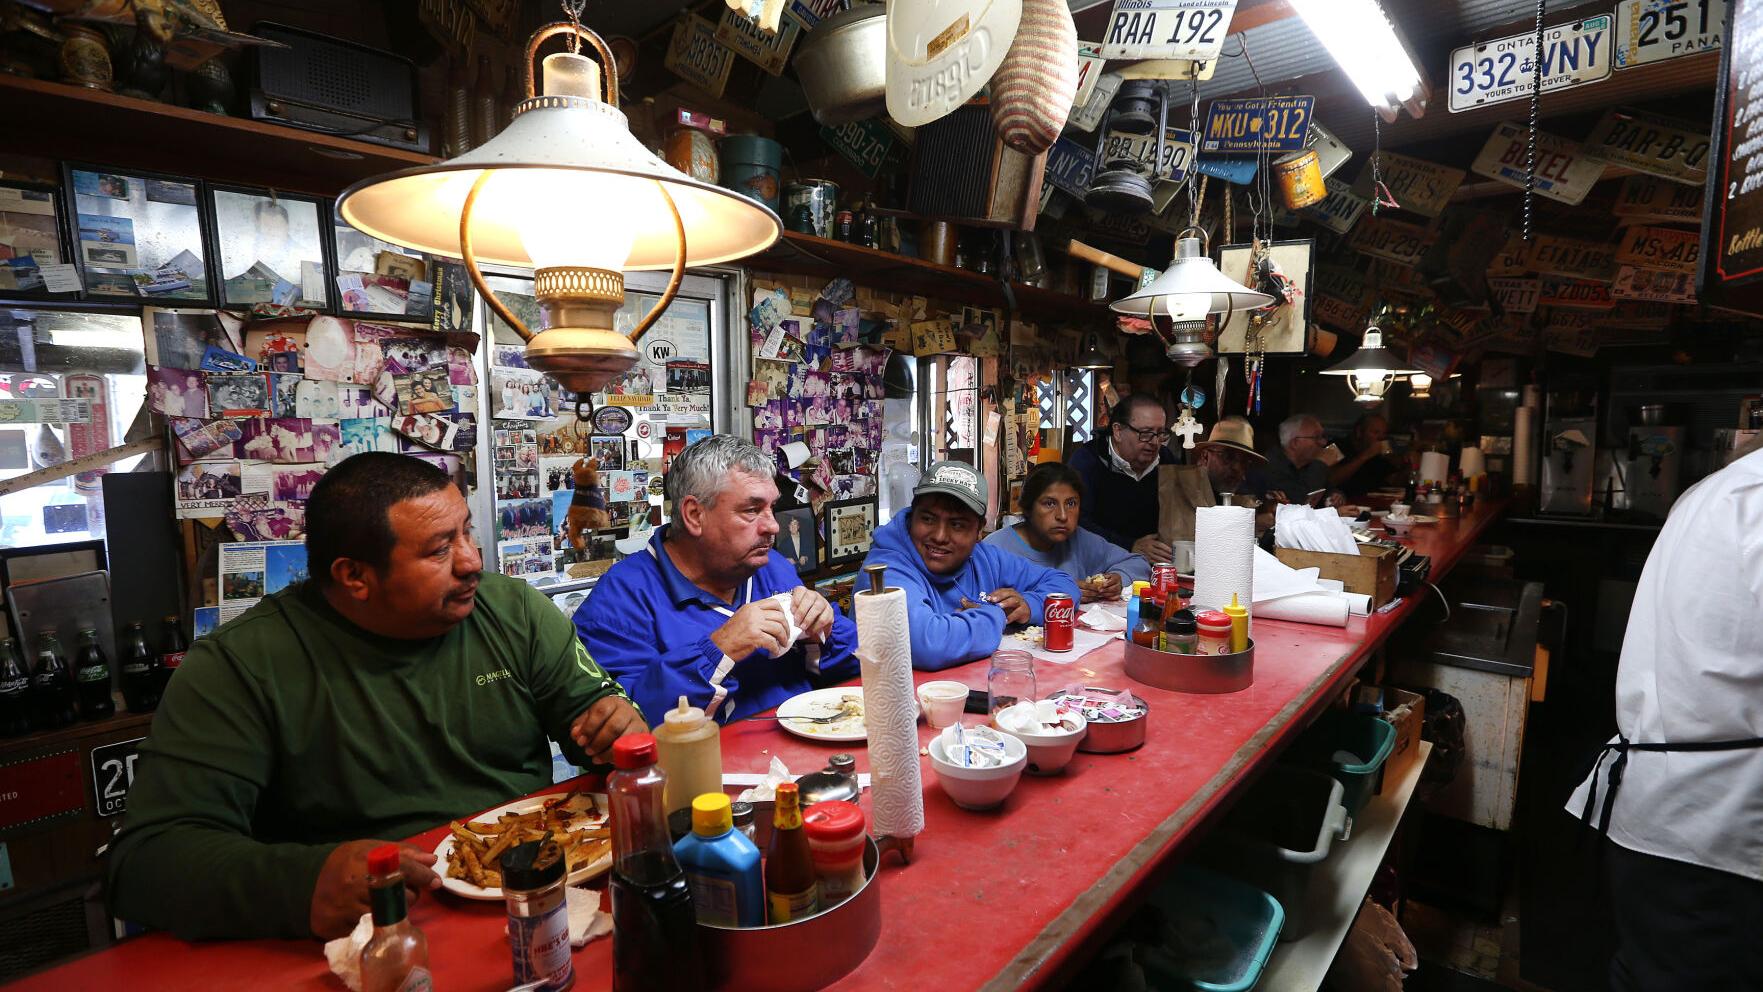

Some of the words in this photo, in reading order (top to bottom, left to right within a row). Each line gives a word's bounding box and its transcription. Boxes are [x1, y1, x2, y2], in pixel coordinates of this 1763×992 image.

[1119, 0, 1152, 9] Illinois
[1109, 12, 1157, 44] RAA
[1167, 9, 1223, 44] 192
[1496, 31, 1562, 52] ONTAIO
[1457, 53, 1517, 95] 332
[1539, 33, 1603, 77] VNY
[1485, 87, 1512, 98] YOURS
[1514, 84, 1525, 92] TO
[1267, 100, 1296, 109] Friend
[1210, 111, 1249, 139] MKU
[1264, 108, 1305, 139] 312
[652, 346, 670, 359] KW
[658, 394, 680, 403] Thank
[180, 501, 200, 509] VERY
